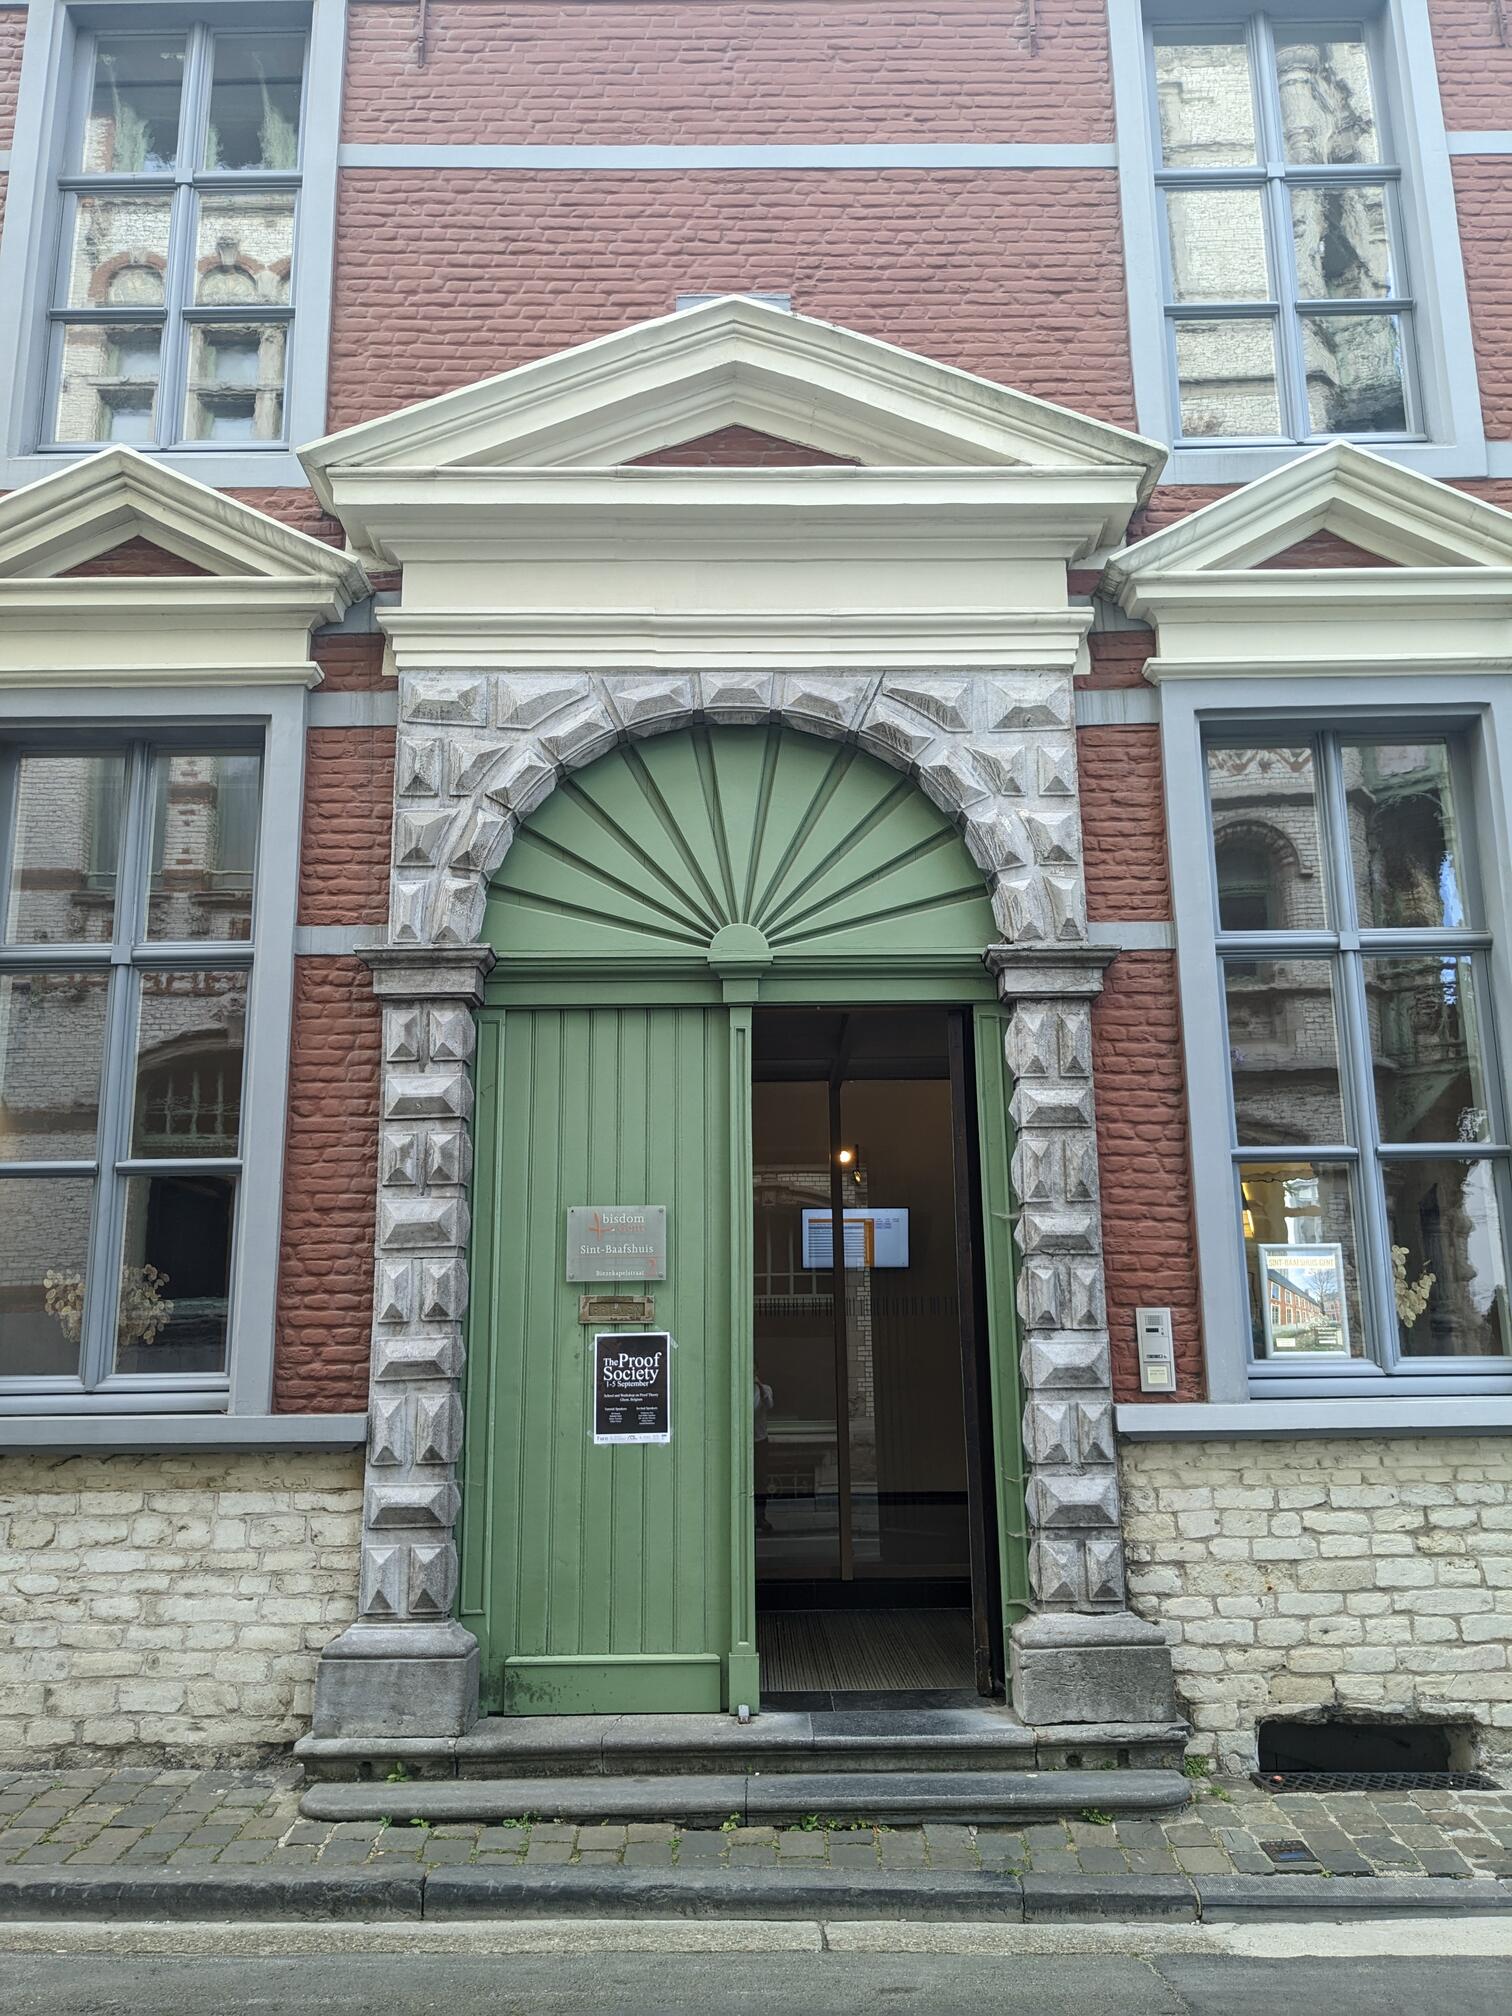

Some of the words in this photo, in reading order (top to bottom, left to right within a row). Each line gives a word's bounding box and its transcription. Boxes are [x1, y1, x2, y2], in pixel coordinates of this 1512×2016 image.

[602, 1213, 645, 1223] bisdom
[580, 1243, 654, 1254] Sint-Baafshuis
[602, 1357, 619, 1366] The
[618, 1351, 662, 1367] Proof
[603, 1366, 659, 1384] Society
[606, 1380, 617, 1388] 1-5
[617, 1380, 649, 1389] September
